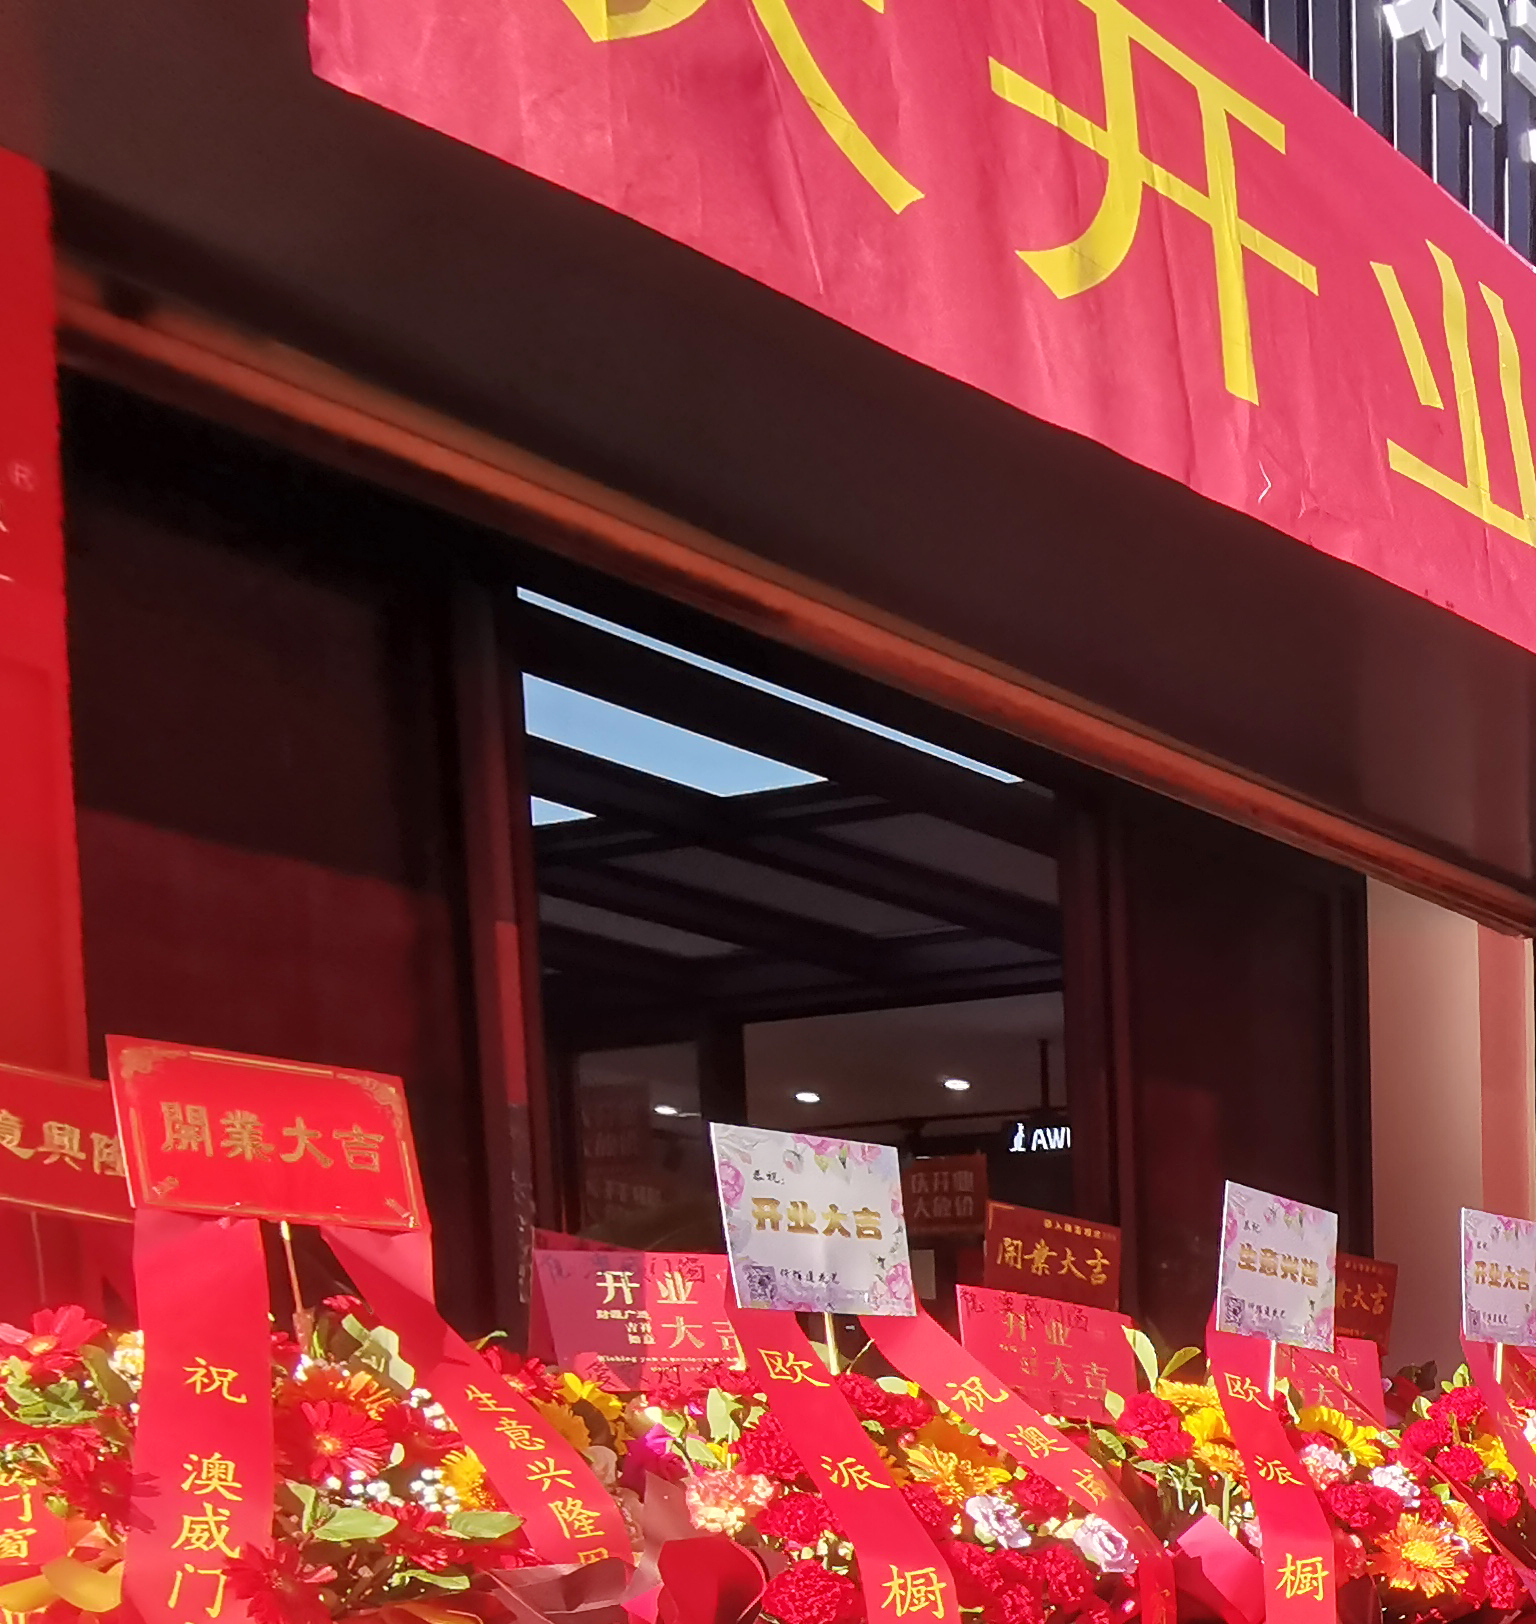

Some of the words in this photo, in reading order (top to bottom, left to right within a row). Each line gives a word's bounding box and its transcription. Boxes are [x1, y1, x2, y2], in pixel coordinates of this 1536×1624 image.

[160, 1101, 385, 1173] 開業大吉
[751, 1197, 883, 1241] 开业大吉
[996, 1237, 1112, 1287] 開業大吉
[1473, 1259, 1532, 1292] 开业大吉
[595, 1270, 701, 1305] 开业
